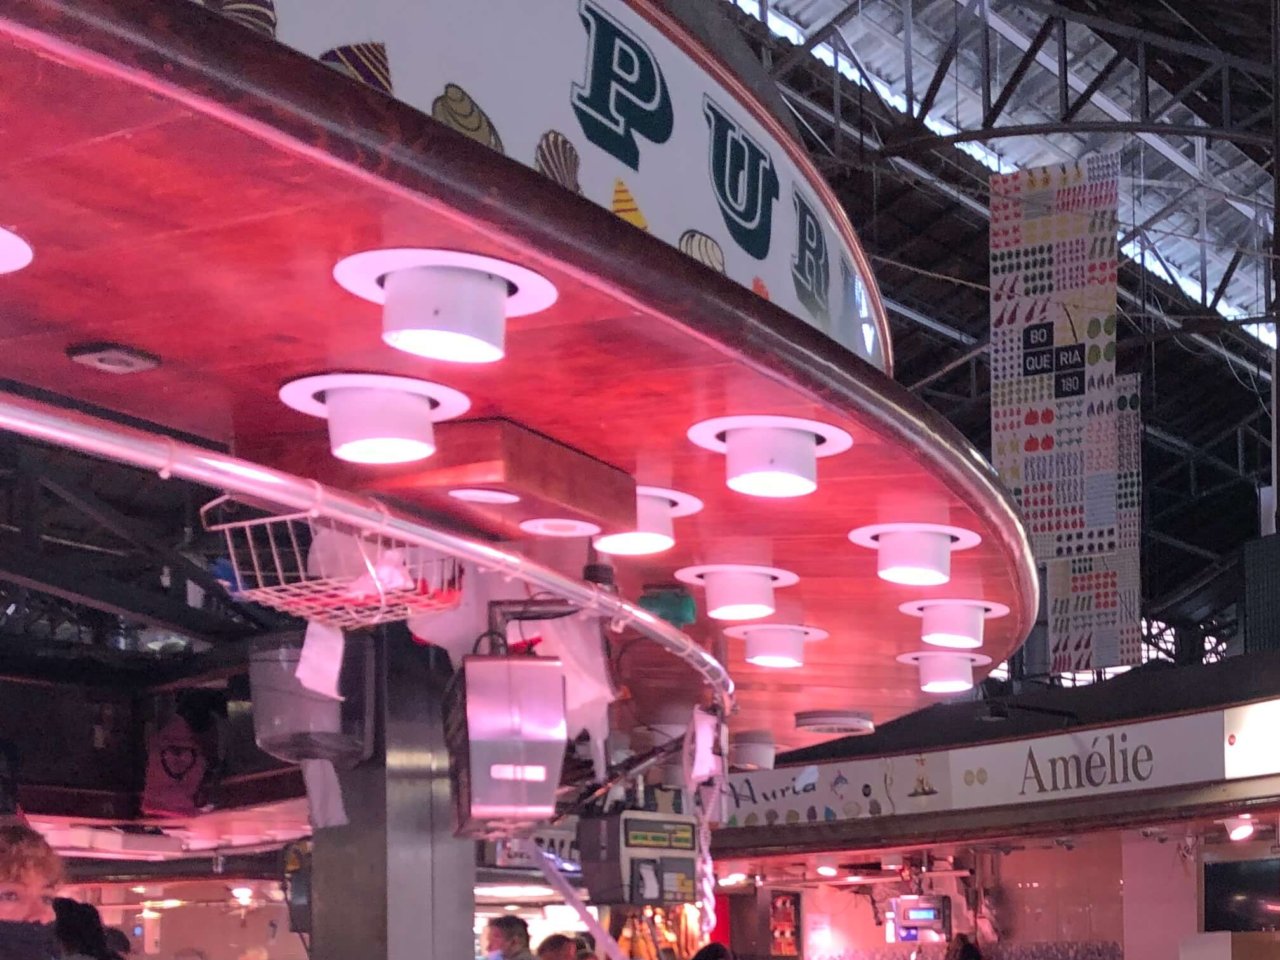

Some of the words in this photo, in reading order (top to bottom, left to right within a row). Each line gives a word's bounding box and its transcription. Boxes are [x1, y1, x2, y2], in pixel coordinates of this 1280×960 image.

[570, 0, 854, 326] PUR
[1030, 328, 1047, 344] BO
[1026, 354, 1052, 371] QUE
[1060, 350, 1081, 366] RIA
[1018, 732, 1153, 796] Amélie
